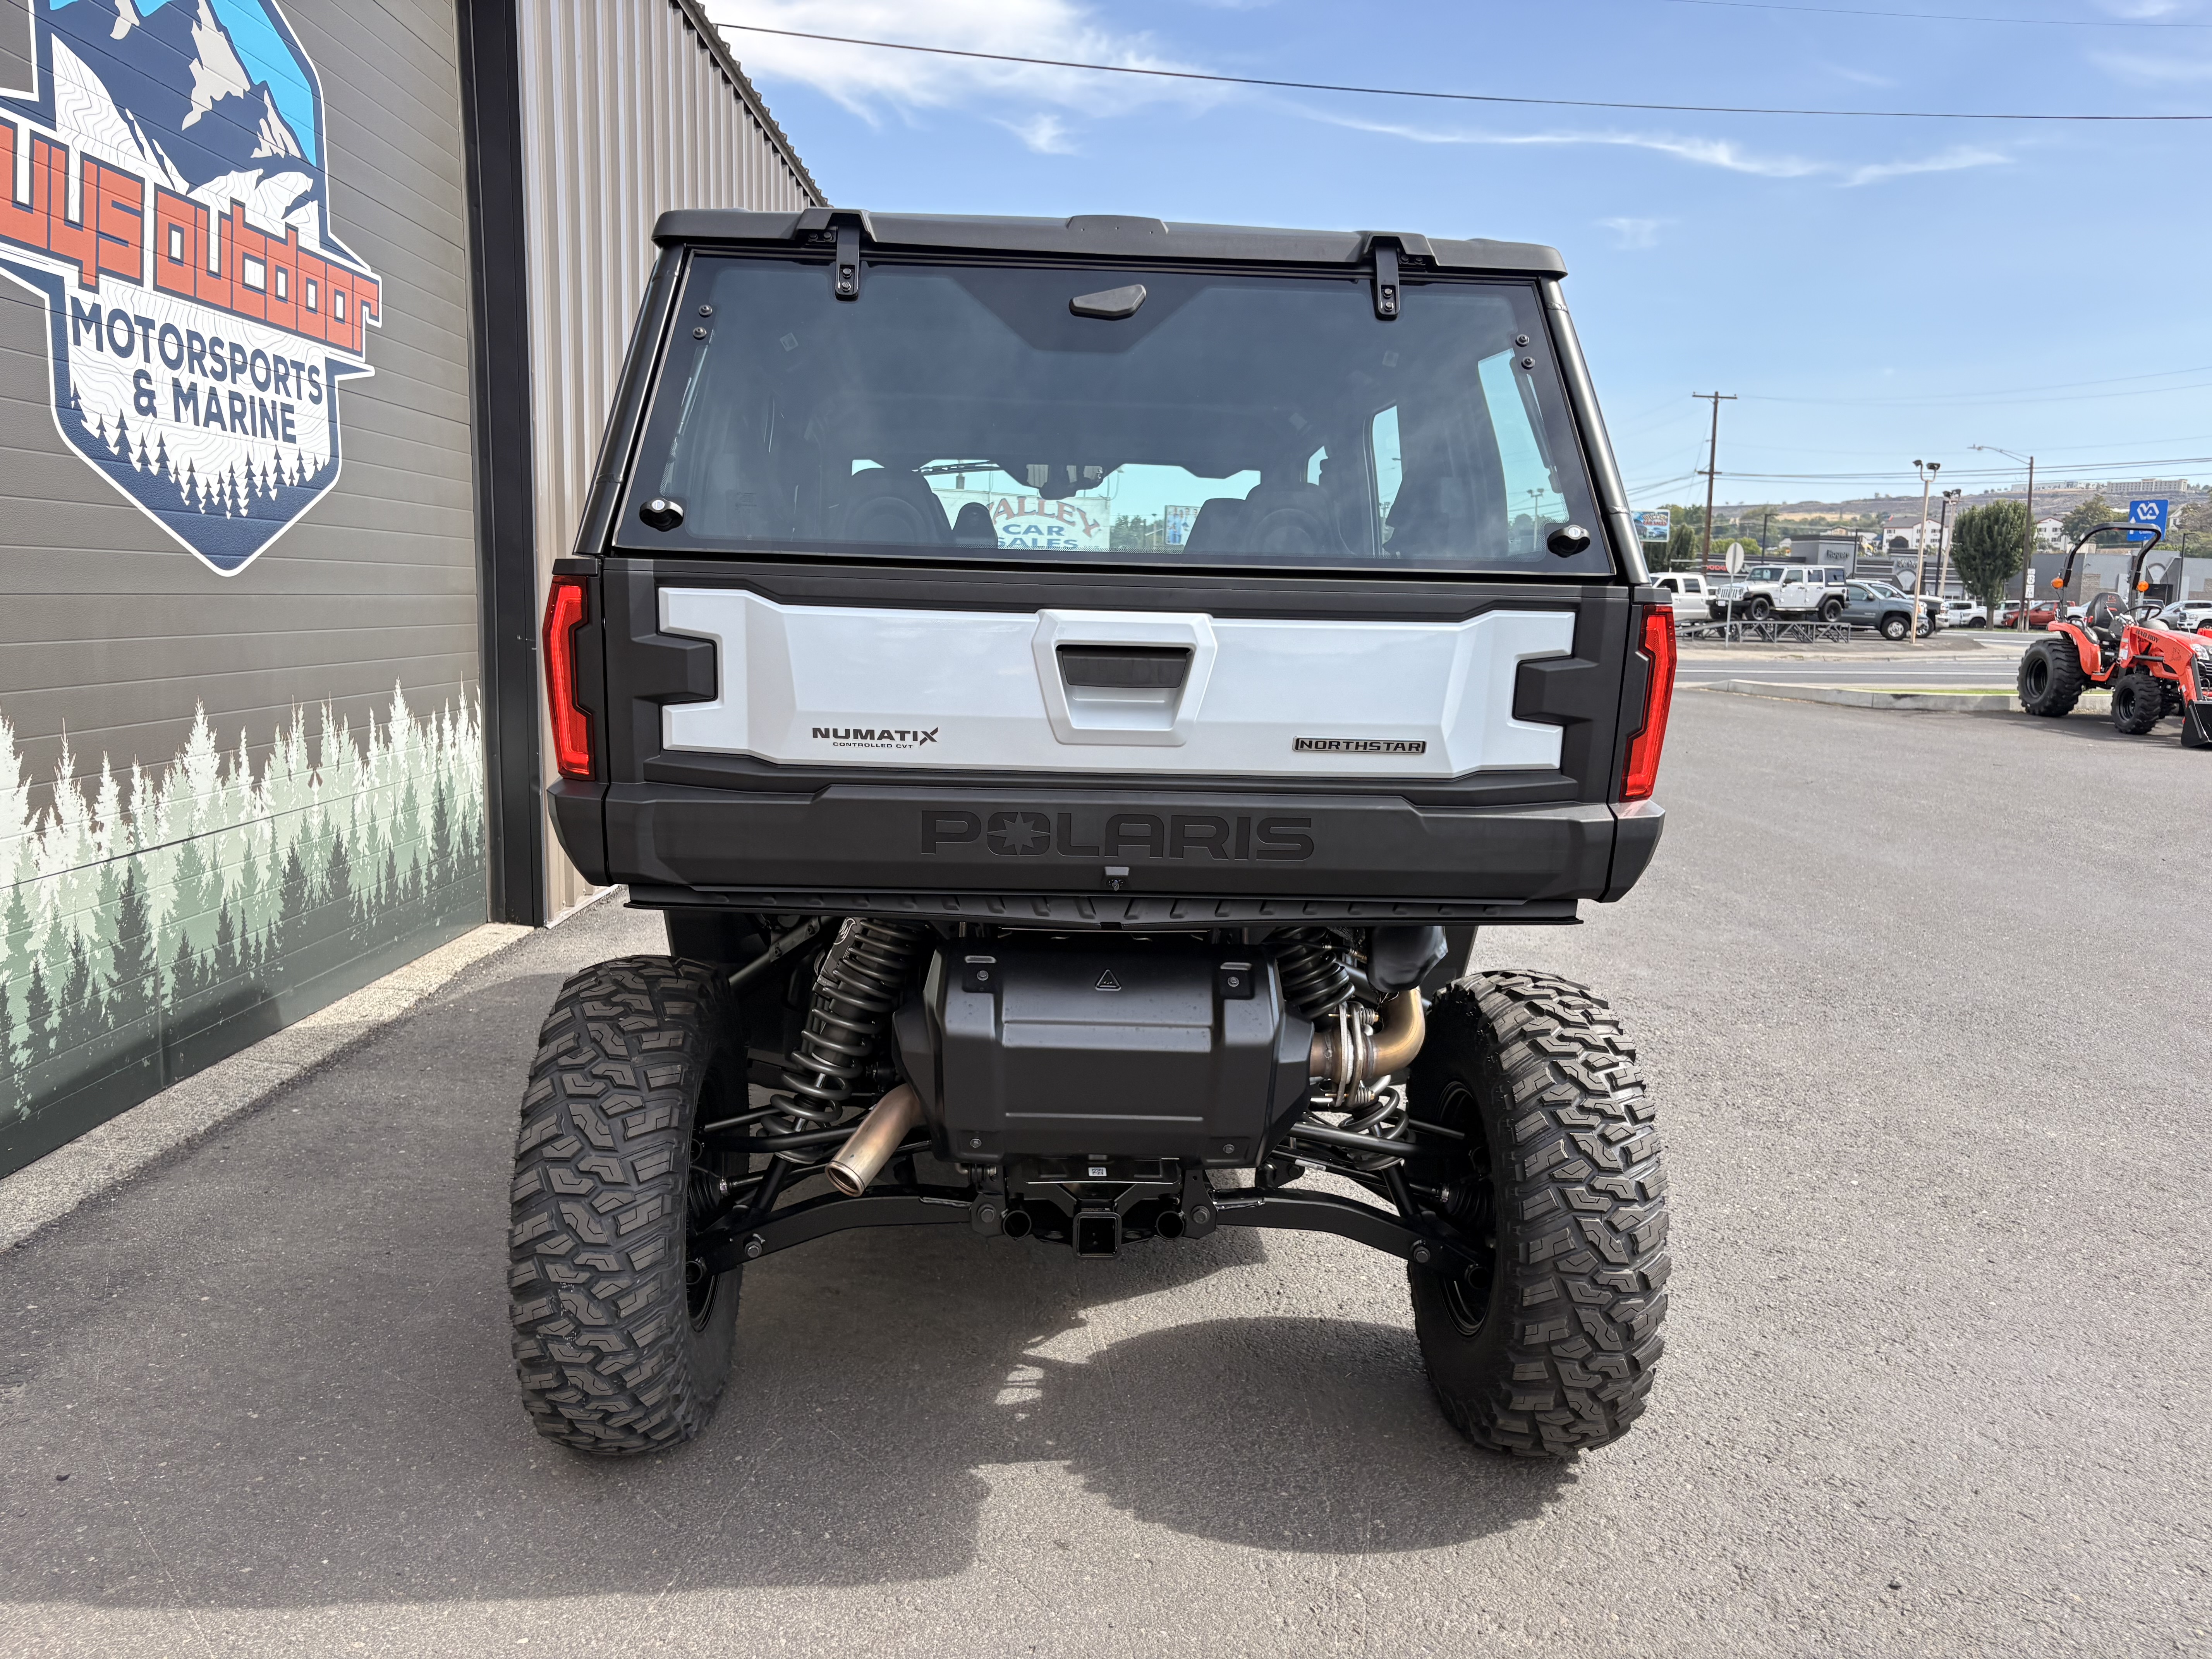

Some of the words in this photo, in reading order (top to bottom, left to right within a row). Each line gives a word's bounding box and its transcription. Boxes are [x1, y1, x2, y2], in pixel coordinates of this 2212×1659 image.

[71, 296, 322, 405] MOTORSPORTS
[133, 369, 157, 419] &
[173, 377, 297, 445] MARINE
[1003, 524, 1065, 536] CAR
[812, 726, 939, 746] NUMATIX
[1300, 740, 1421, 752] NORTHSTAR
[921, 810, 1315, 861] POLARIS
